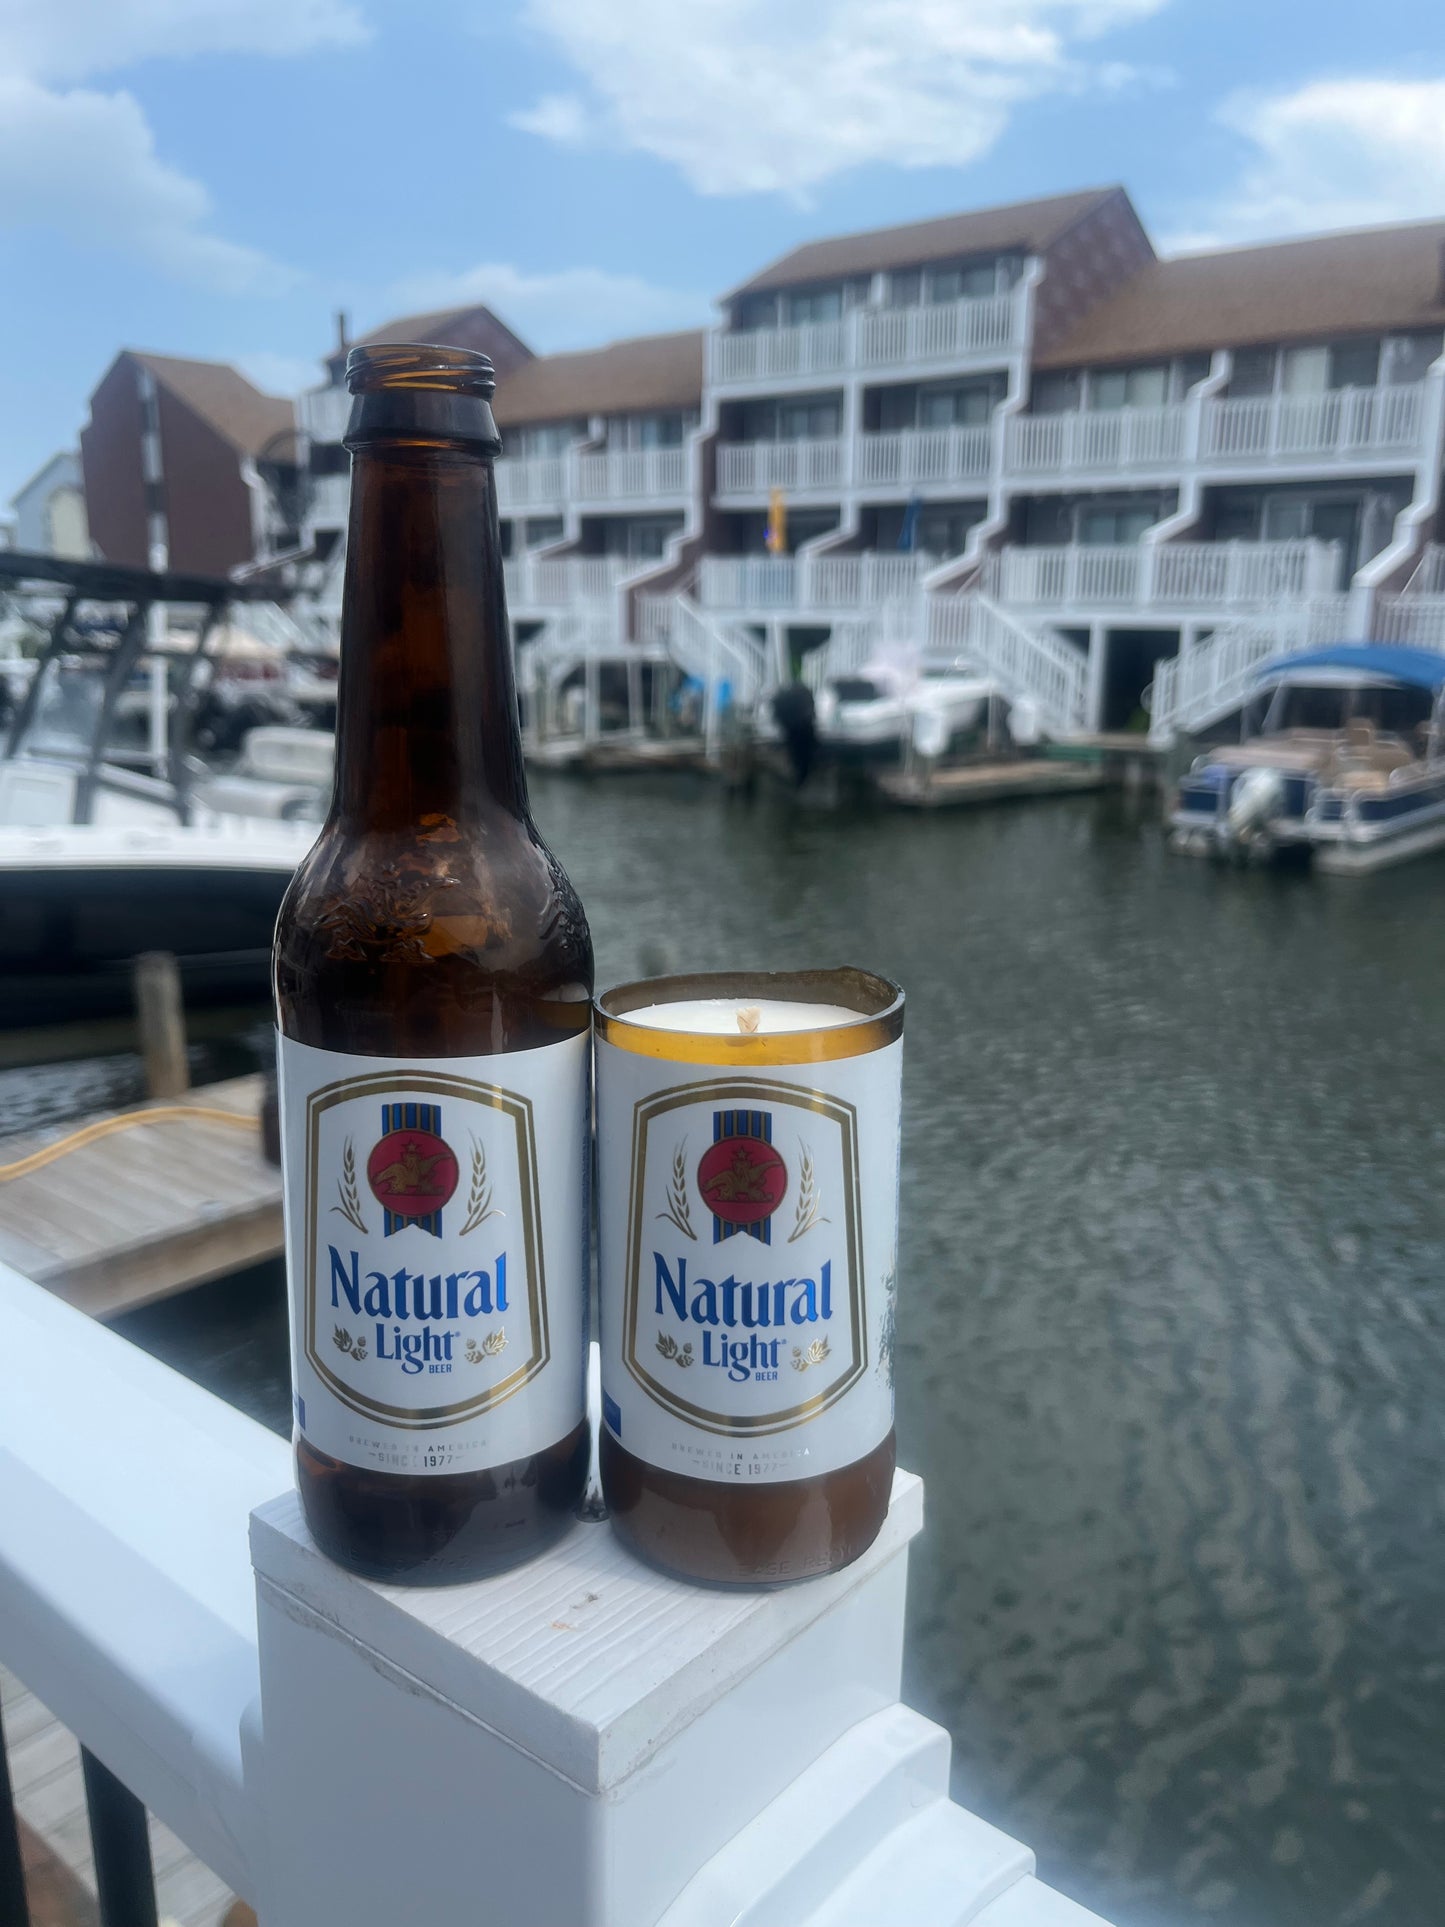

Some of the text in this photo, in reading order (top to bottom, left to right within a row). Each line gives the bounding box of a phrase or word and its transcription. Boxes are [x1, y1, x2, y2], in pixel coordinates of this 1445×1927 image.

[328, 1244, 509, 1320] Natural
[653, 1251, 833, 1327] Natural
[376, 1323, 455, 1375] Light
[703, 1330, 779, 1382] Light
[428, 1364, 453, 1374] BEER
[755, 1371, 779, 1381] BEER
[423, 1454, 454, 1468] 1977
[730, 1452, 744, 1461] IN
[747, 1463, 777, 1476] 1977
